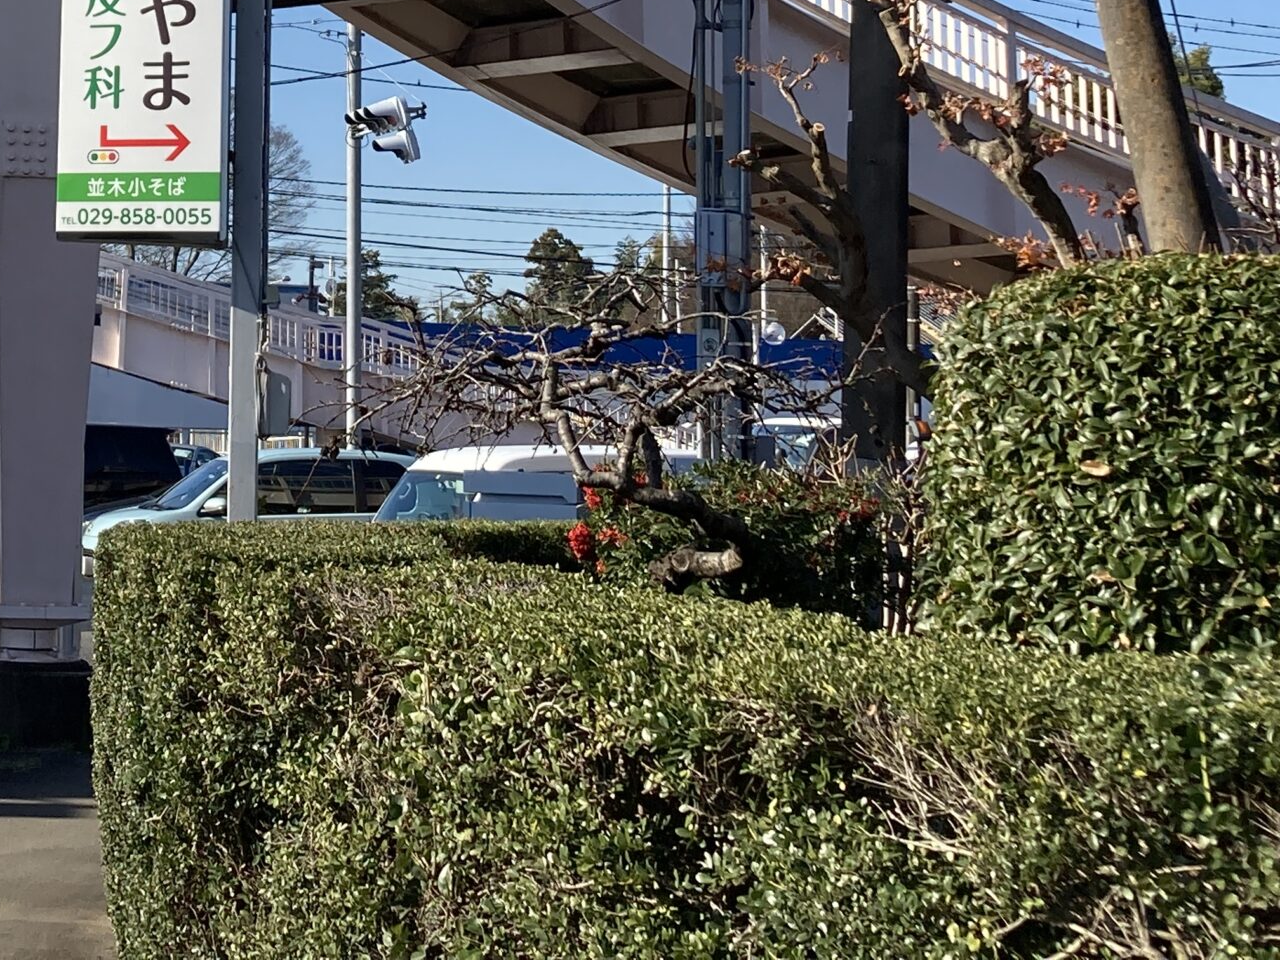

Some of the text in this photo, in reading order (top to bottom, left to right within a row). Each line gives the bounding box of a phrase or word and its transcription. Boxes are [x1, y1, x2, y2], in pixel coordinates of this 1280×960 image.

[87, 177, 187, 197] 並木小そば
[77, 207, 212, 225] 029-858-0055
